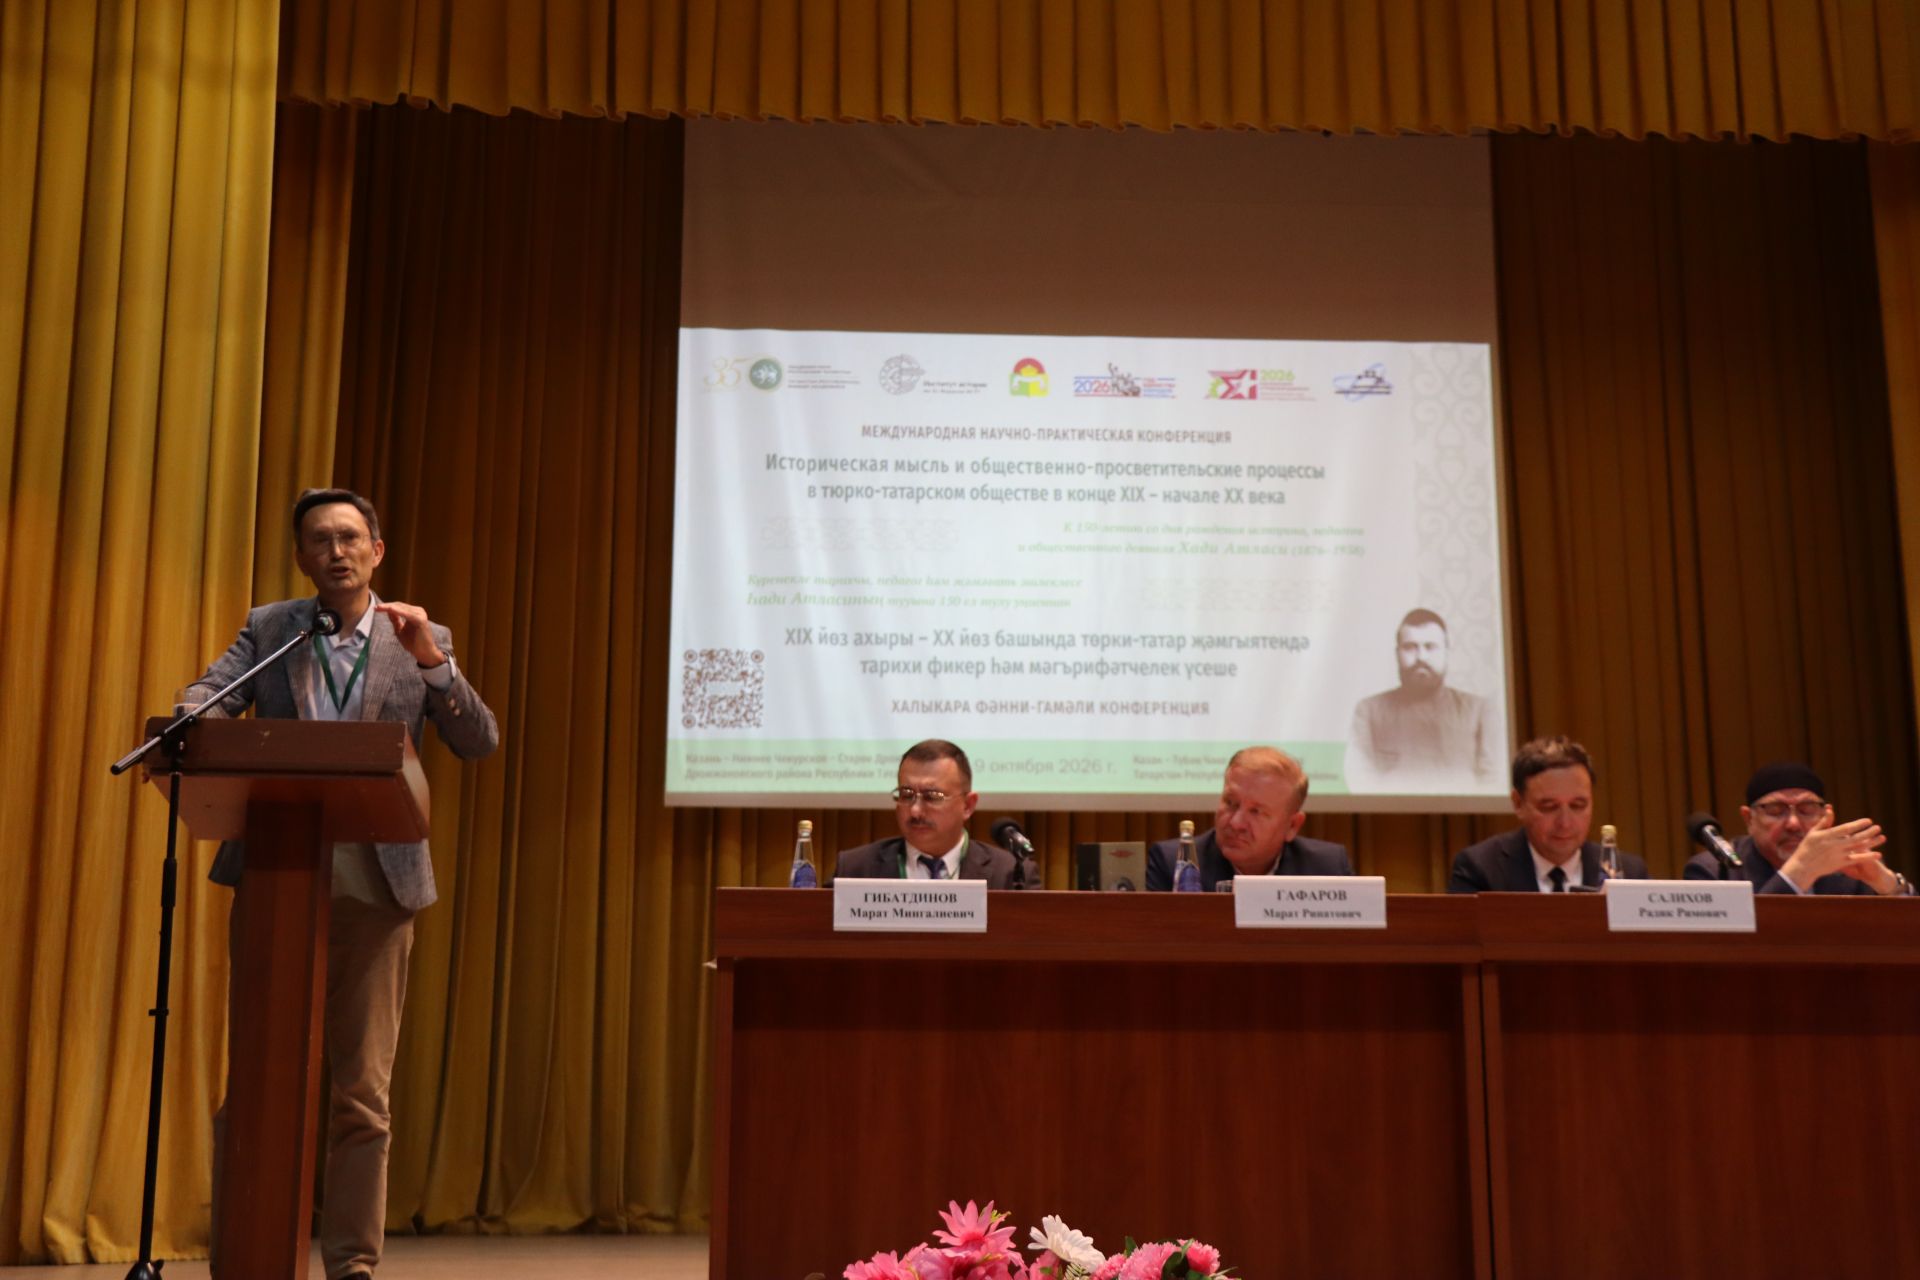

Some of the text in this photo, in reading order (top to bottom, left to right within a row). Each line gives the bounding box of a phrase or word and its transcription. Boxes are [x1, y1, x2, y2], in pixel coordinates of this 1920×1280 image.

[1259, 368, 1296, 382] 2026
[1073, 379, 1111, 393] 2026
[861, 425, 1232, 444] МЕЖДУНАРОДНАЯ НАУЧНО-ПРАКТИЧЕСКАЯ КОНФЕРЕНЦИЯ
[765, 453, 1326, 483] Историческая мысль и общественно-просветительские процессы
[807, 485, 817, 499] в
[821, 485, 966, 504] тюрко-татарском
[970, 484, 1050, 504] обществе
[1054, 488, 1063, 501] в
[1067, 488, 1116, 505] конце
[1120, 486, 1145, 502] XIX
[1162, 489, 1220, 504] начале
[1248, 490, 1286, 505] века
[784, 627, 813, 646] XIX
[818, 626, 849, 646] йөз
[853, 631, 914, 651] ахыры
[959, 626, 990, 647] йөз
[995, 629, 1076, 651] башында
[1081, 633, 1187, 652] төрки-татар
[1192, 635, 1310, 653] җәмгыятендә
[860, 655, 1238, 680] тарихи фикер һәм мәгърифәтчелек үсеше
[891, 699, 1211, 718] ХАЛЫКАРА ФӘННИ-ГАМӘЛИ КОНФЕРЕНЦИЯ
[989, 757, 1054, 776] октября
[1058, 757, 1103, 774] 2026
[1107, 761, 1118, 774] г.
[863, 891, 958, 905] ГИБАТДИНОВ
[1276, 888, 1348, 902] ГАФАРОВ
[1647, 892, 1714, 904] САЛИХОВ
[850, 907, 975, 921] Марат Мингалиевич
[1262, 907, 1362, 921] Марат Ринатович
[1638, 907, 1728, 919] Радик Римович
